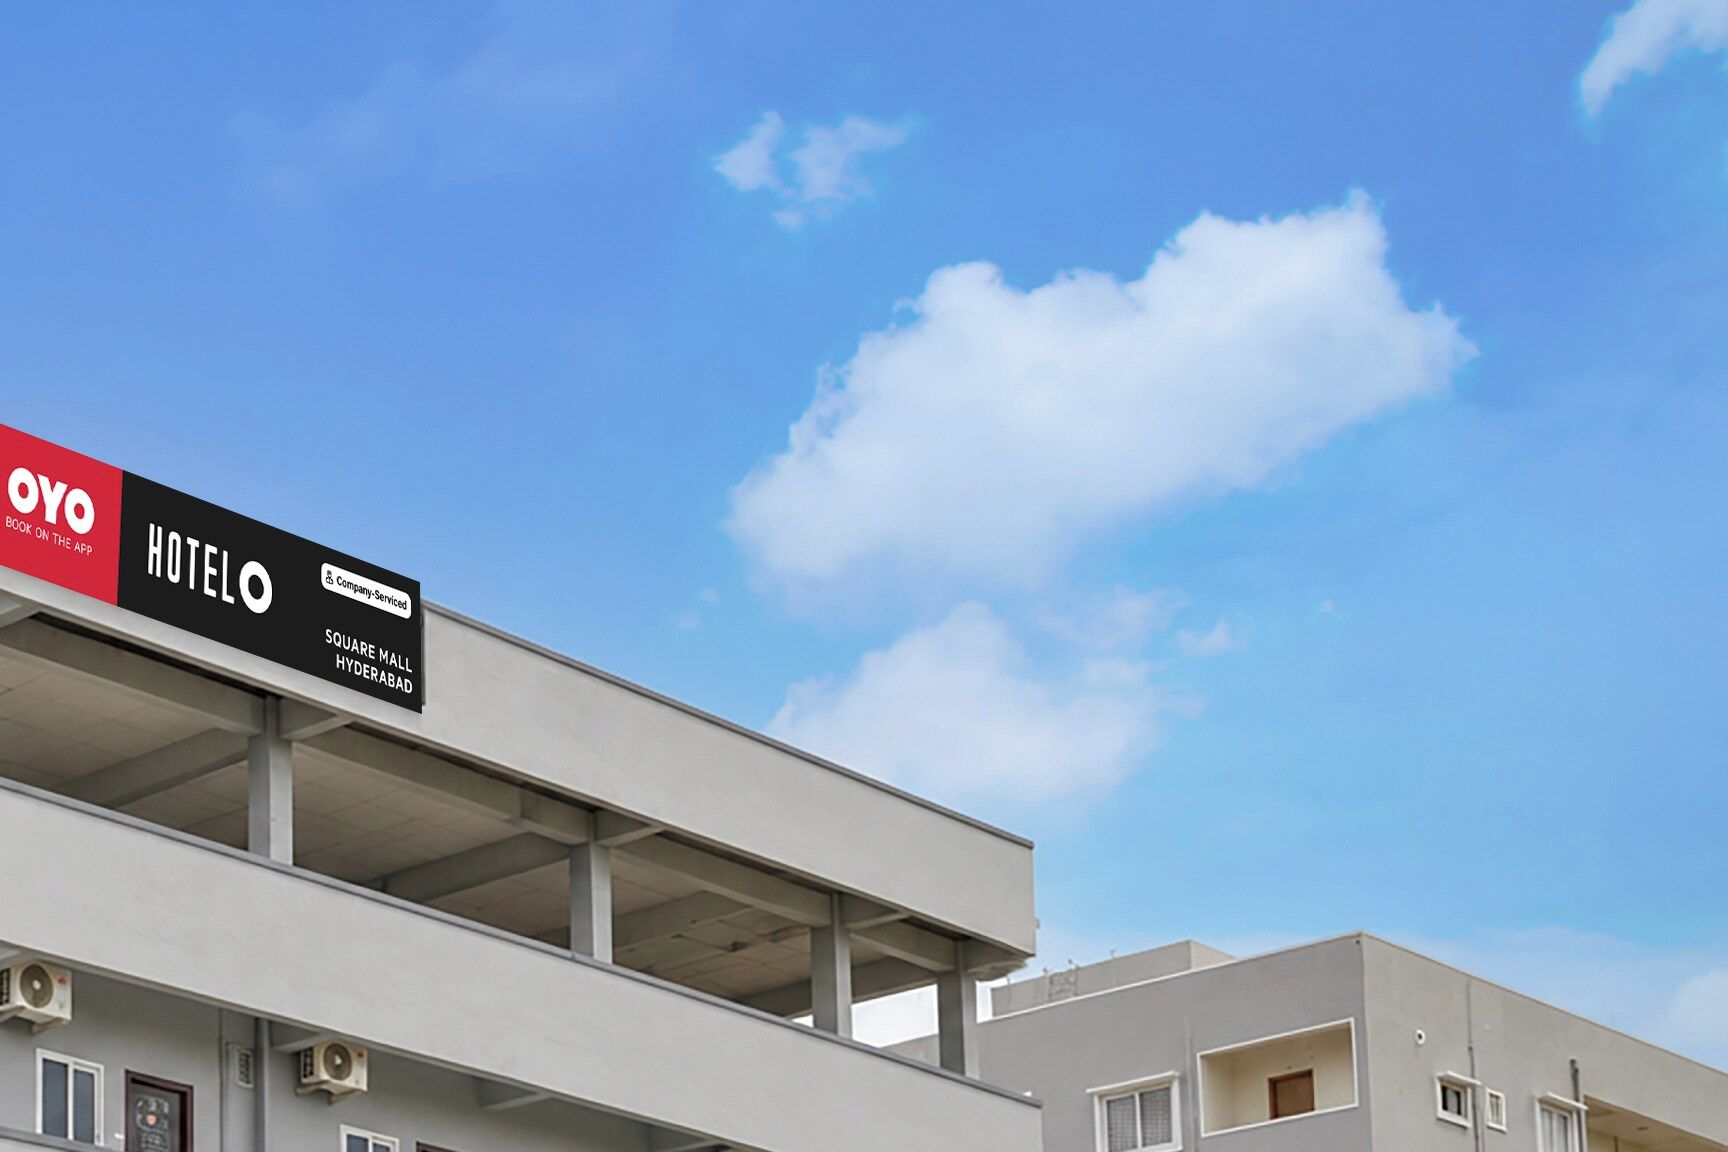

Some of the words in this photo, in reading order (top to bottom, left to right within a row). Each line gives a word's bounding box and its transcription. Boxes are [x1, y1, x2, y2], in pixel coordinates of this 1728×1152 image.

[7, 466, 95, 535] OYO
[5, 515, 33, 536] BOOK
[35, 526, 50, 541] ON
[52, 532, 72, 550] THE
[73, 541, 93, 556] APP
[336, 575, 408, 611] Company-Serviced
[325, 628, 376, 660] SQUARE
[379, 647, 413, 674] MALL
[336, 653, 413, 694] HYDERABAD
